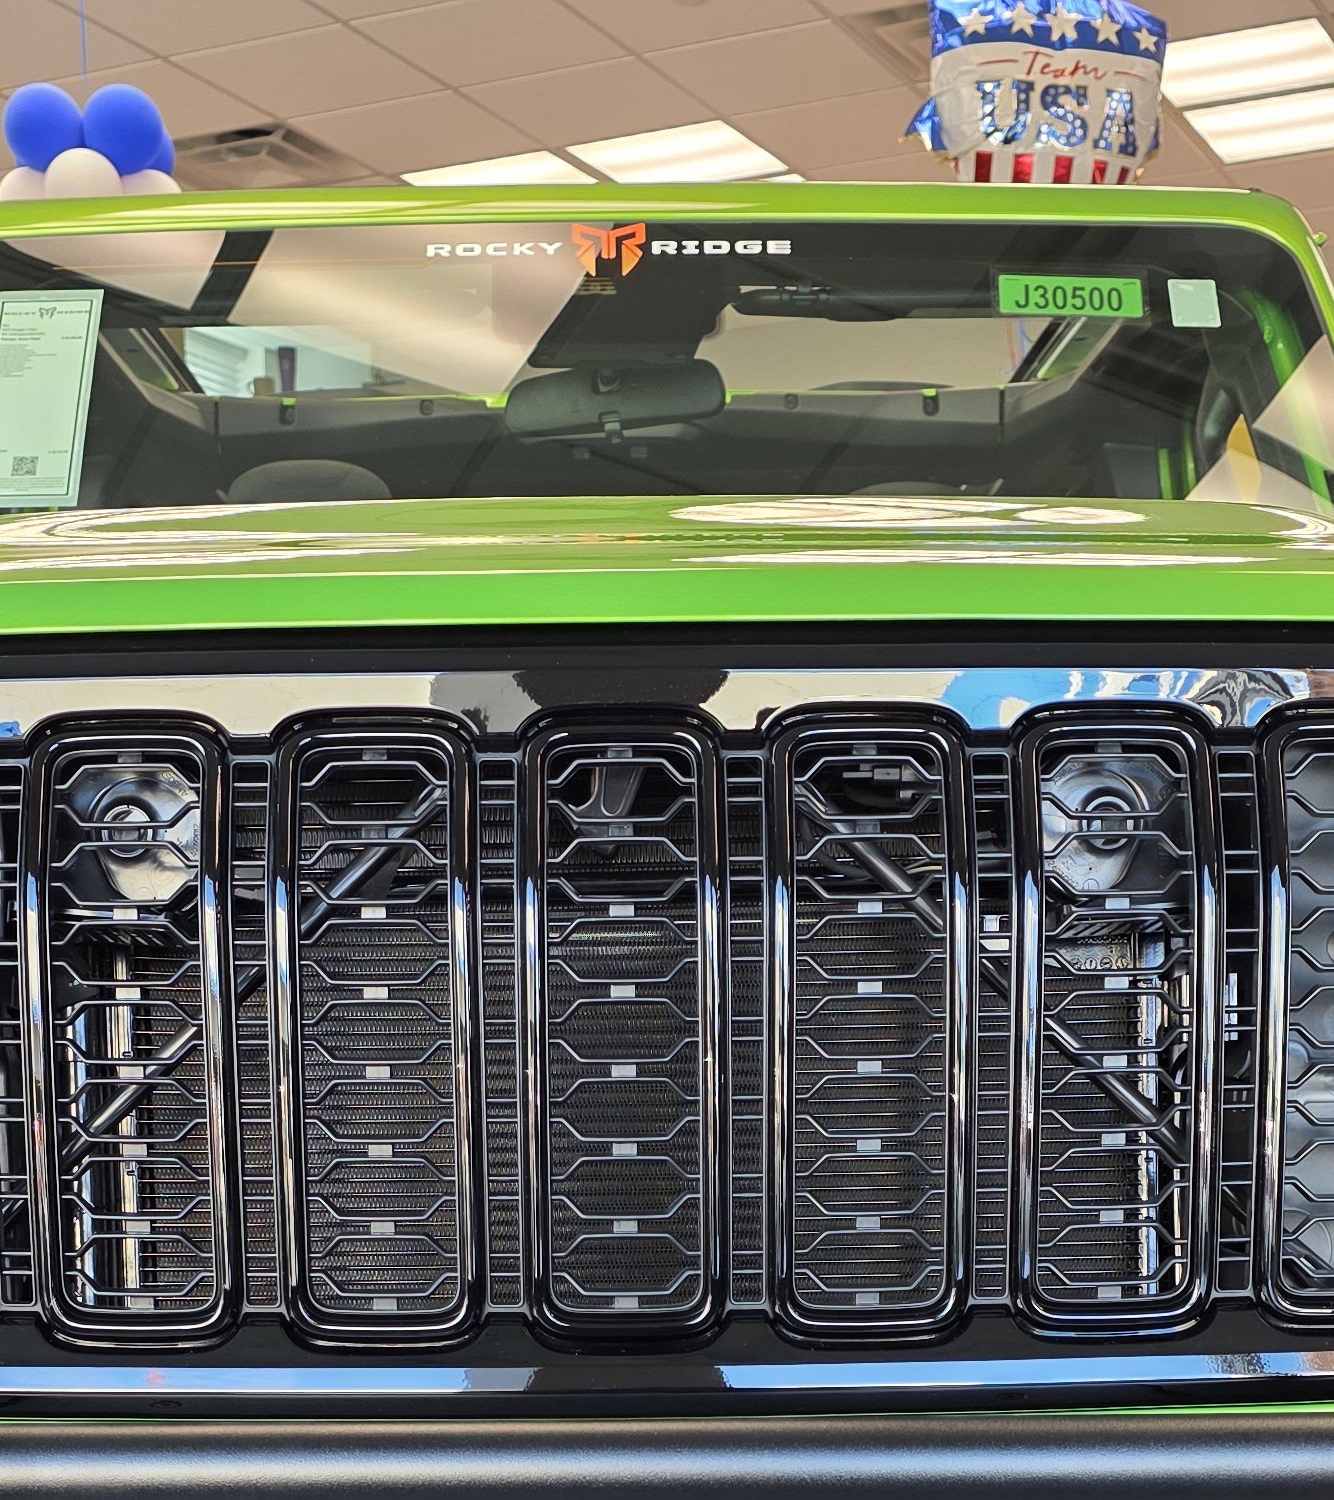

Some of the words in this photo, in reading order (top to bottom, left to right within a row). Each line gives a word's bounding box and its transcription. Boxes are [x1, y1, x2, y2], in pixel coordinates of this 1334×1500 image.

[1023, 50, 1107, 80] Team
[975, 79, 1136, 157] USA
[426, 241, 563, 257] ROCKY
[651, 240, 792, 255] RIDGE
[1014, 284, 1123, 312] J30500
